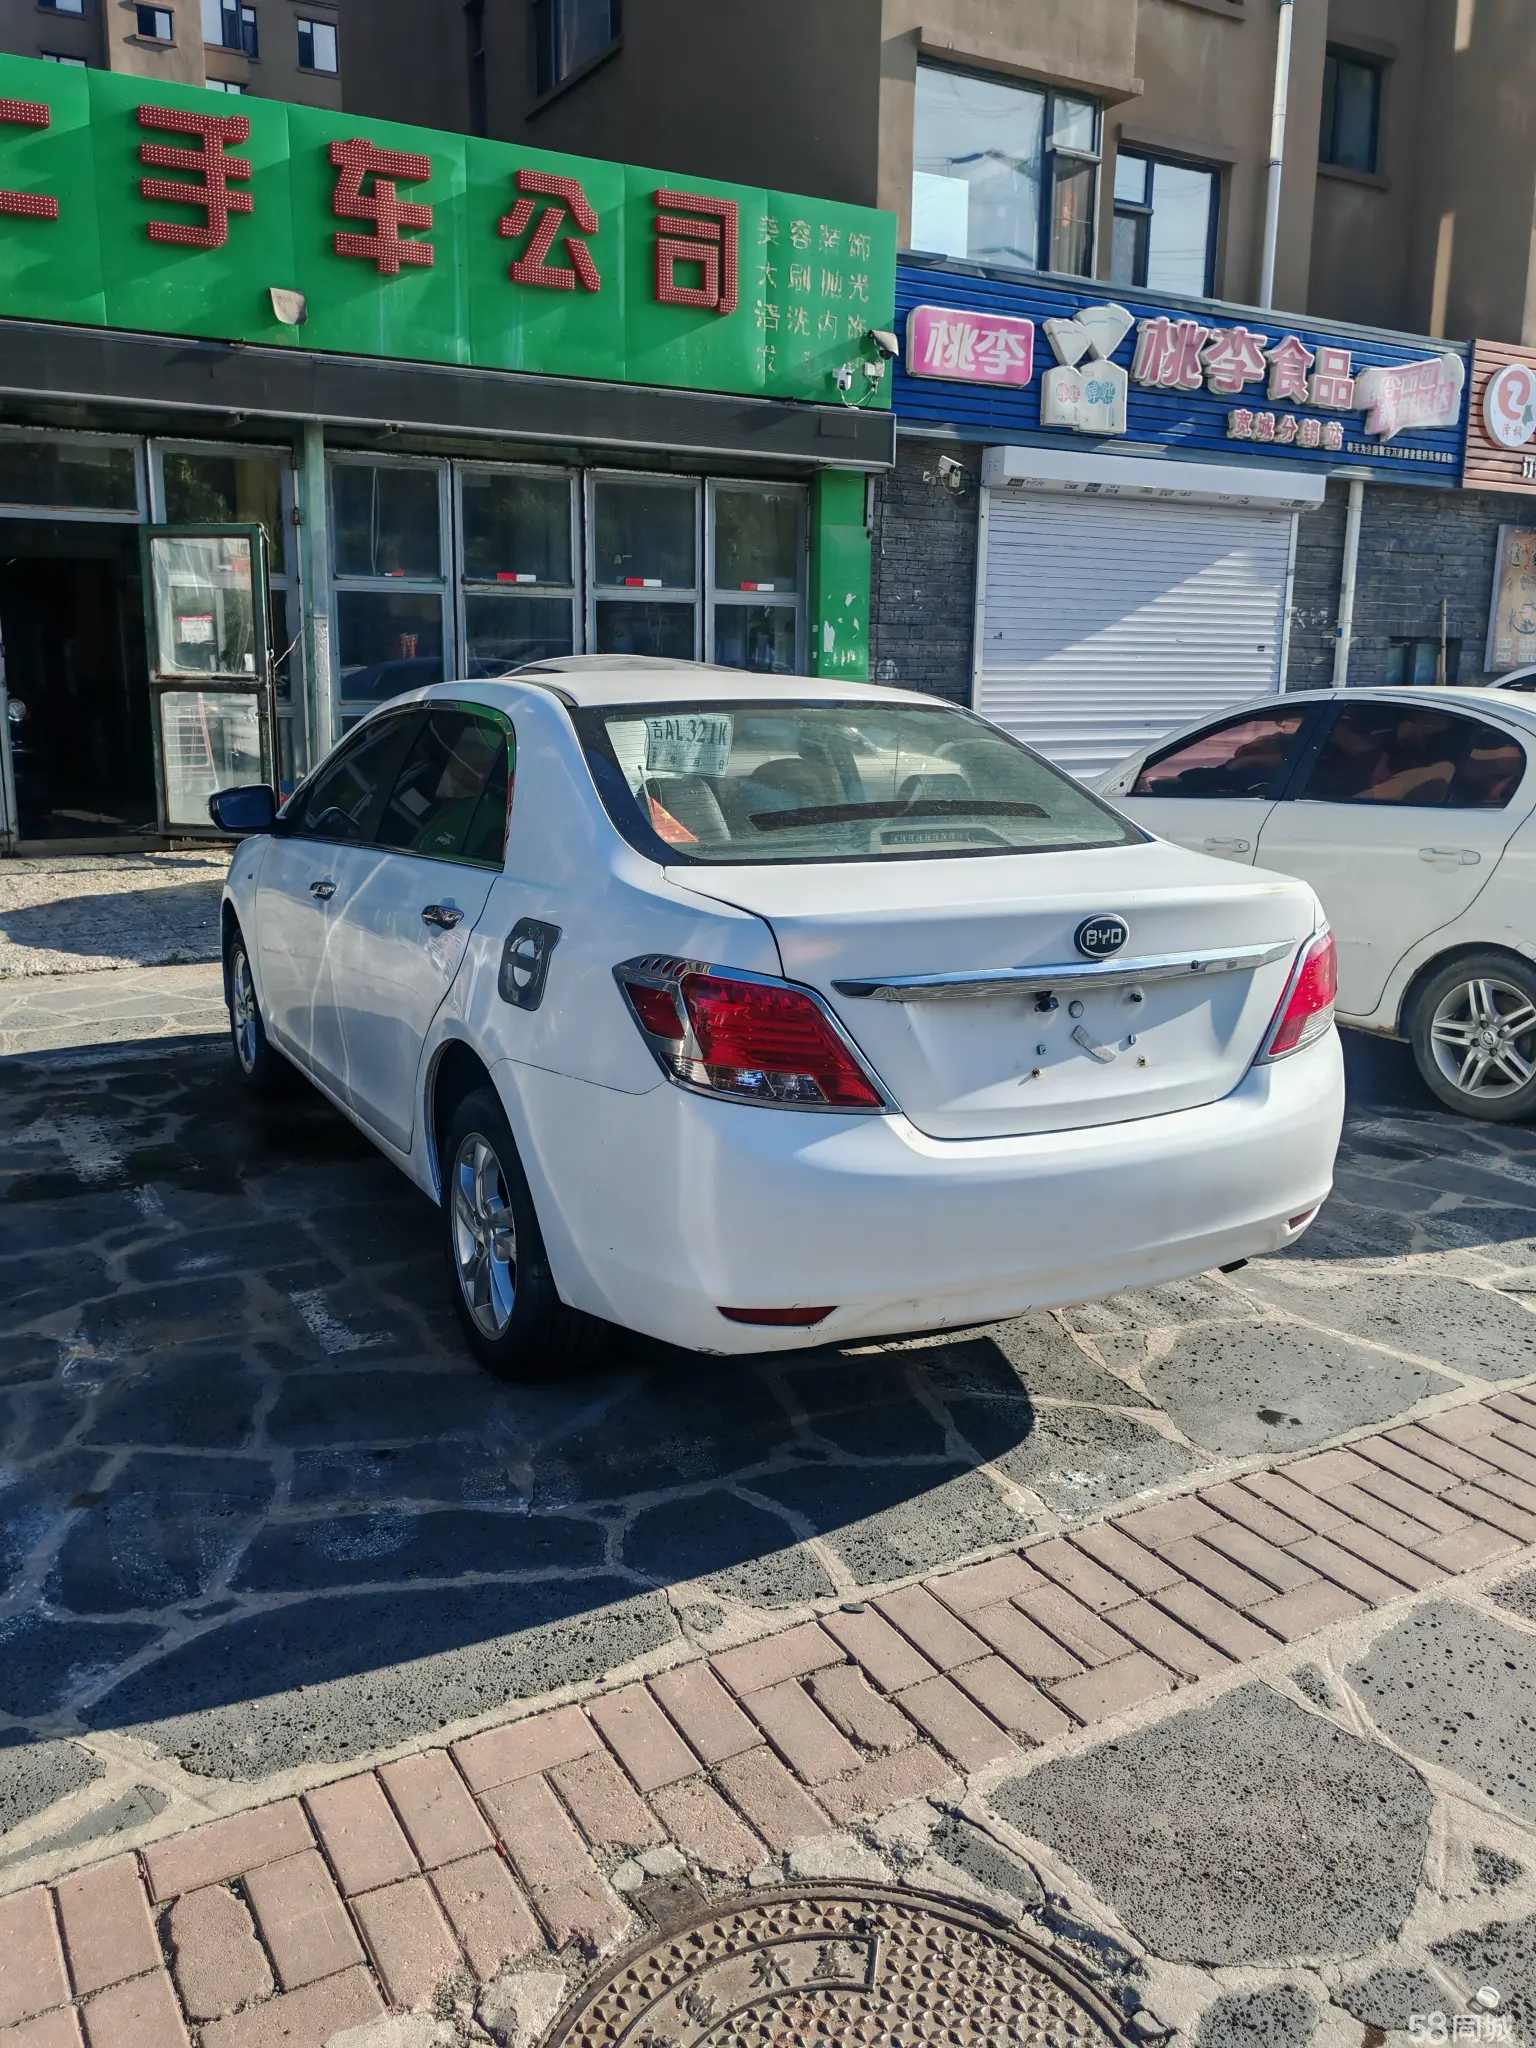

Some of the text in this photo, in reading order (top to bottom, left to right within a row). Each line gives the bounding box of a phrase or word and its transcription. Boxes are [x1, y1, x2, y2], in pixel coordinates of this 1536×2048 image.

[923, 319, 1026, 375] 桃李
[1133, 316, 1355, 410] 桃李食品
[1227, 408, 1344, 452] 宽城分销站
[651, 719, 727, 745] 吉AL321K
[1086, 928, 1122, 946] BYD
